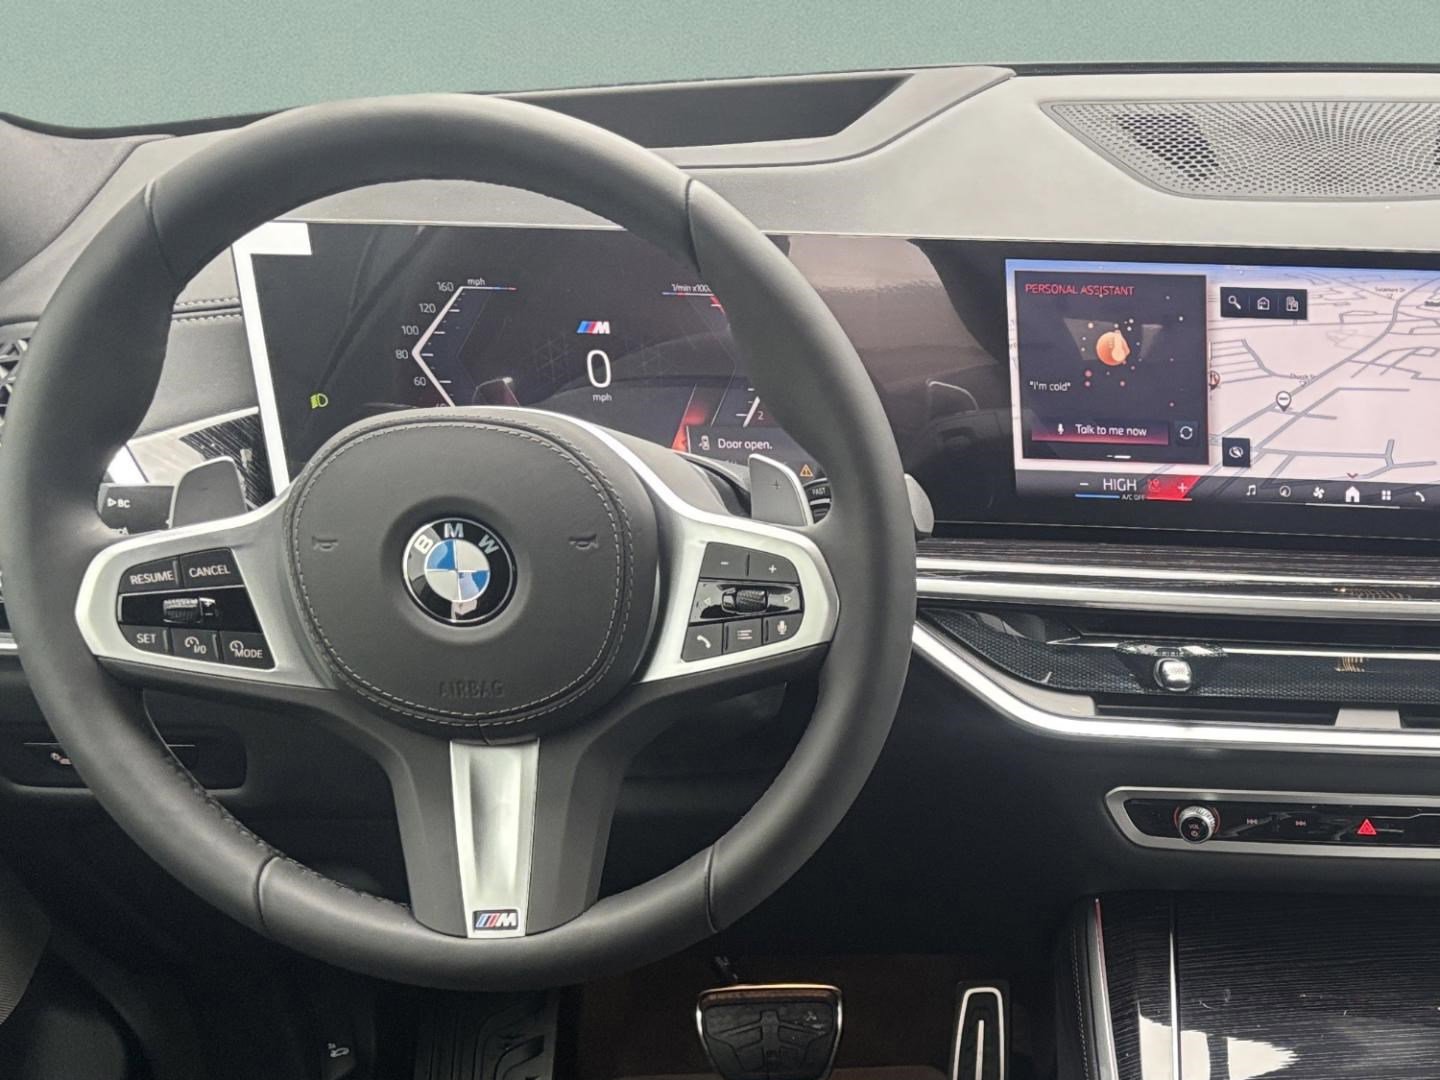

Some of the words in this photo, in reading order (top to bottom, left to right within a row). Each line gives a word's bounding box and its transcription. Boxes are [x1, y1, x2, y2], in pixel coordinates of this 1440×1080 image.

[436, 282, 454, 292] 160
[467, 278, 486, 286] mph
[1024, 283, 1078, 295] PERSONAL
[1080, 285, 1135, 296] ASSISTANT
[419, 303, 436, 313] 120
[401, 326, 419, 336] 100
[395, 350, 409, 360] 80
[587, 350, 611, 388] 0
[414, 377, 426, 387] 60
[592, 393, 612, 402] mph
[1075, 424, 1095, 435] Talk
[1096, 425, 1107, 435] to
[1109, 427, 1125, 436] me
[1127, 428, 1147, 437] now
[718, 439, 742, 450] Door
[744, 440, 773, 452] open.
[1103, 478, 1137, 491] HIGH
[117, 499, 131, 508] BC
[414, 523, 500, 555] BMW
[188, 564, 231, 578] CANCEL
[129, 570, 175, 586] RESUME
[136, 634, 157, 644] SET
[234, 648, 264, 659] MODE
[439, 680, 504, 698] AIRBAG
